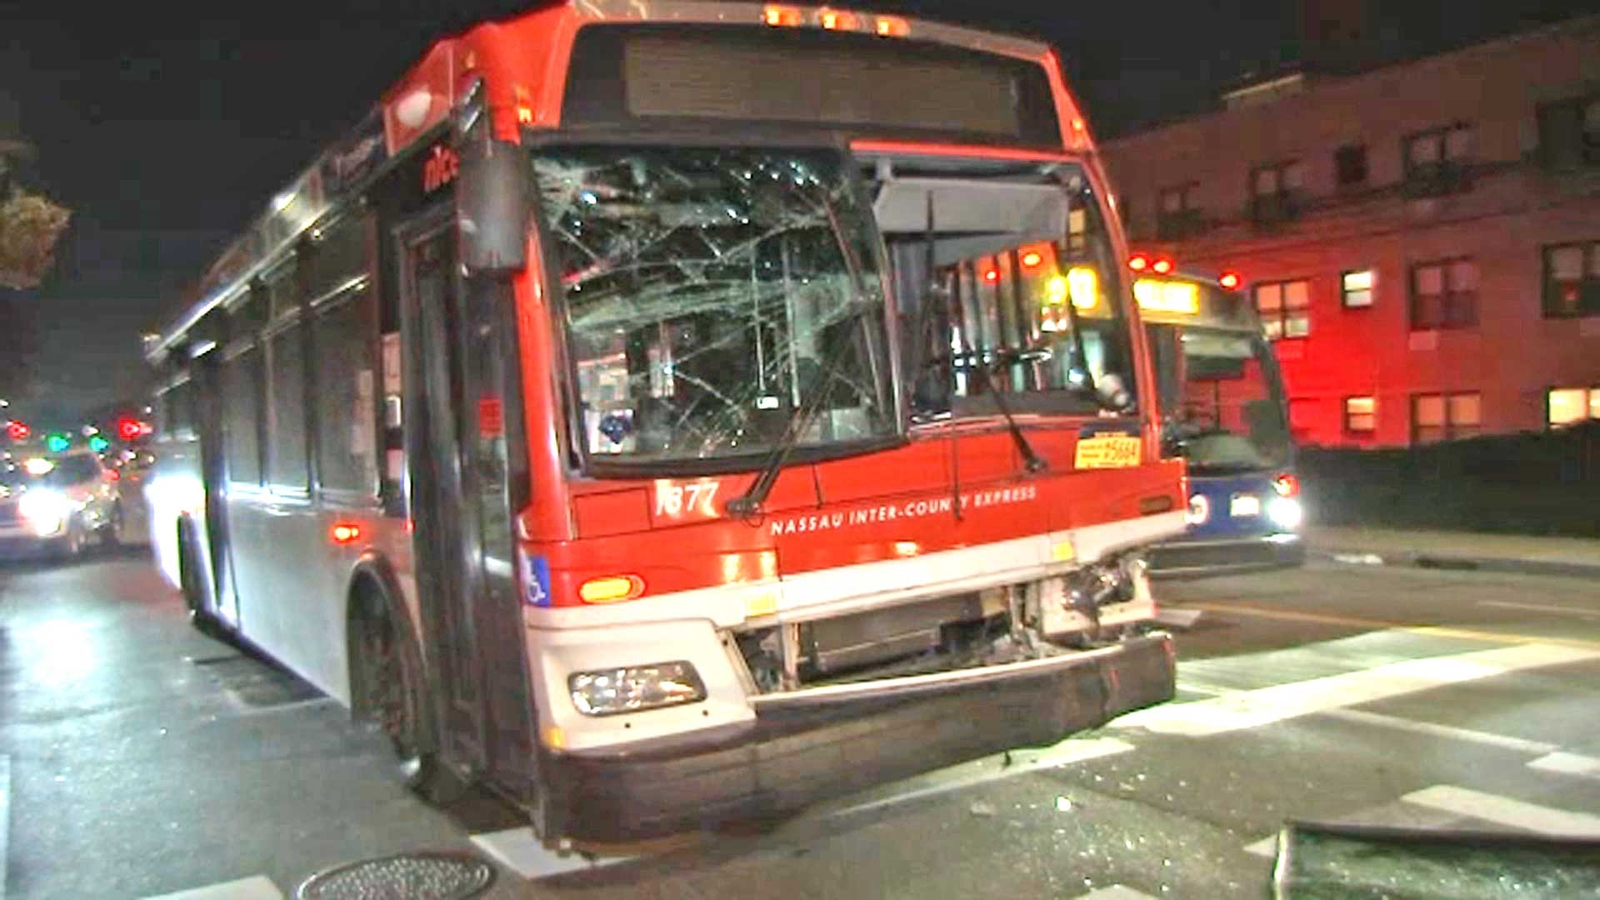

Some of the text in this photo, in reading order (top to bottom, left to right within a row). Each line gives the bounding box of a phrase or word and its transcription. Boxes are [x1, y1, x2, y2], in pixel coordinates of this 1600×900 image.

[771, 486, 1037, 535] NASSAU INTER-COUNY EXPRESS
